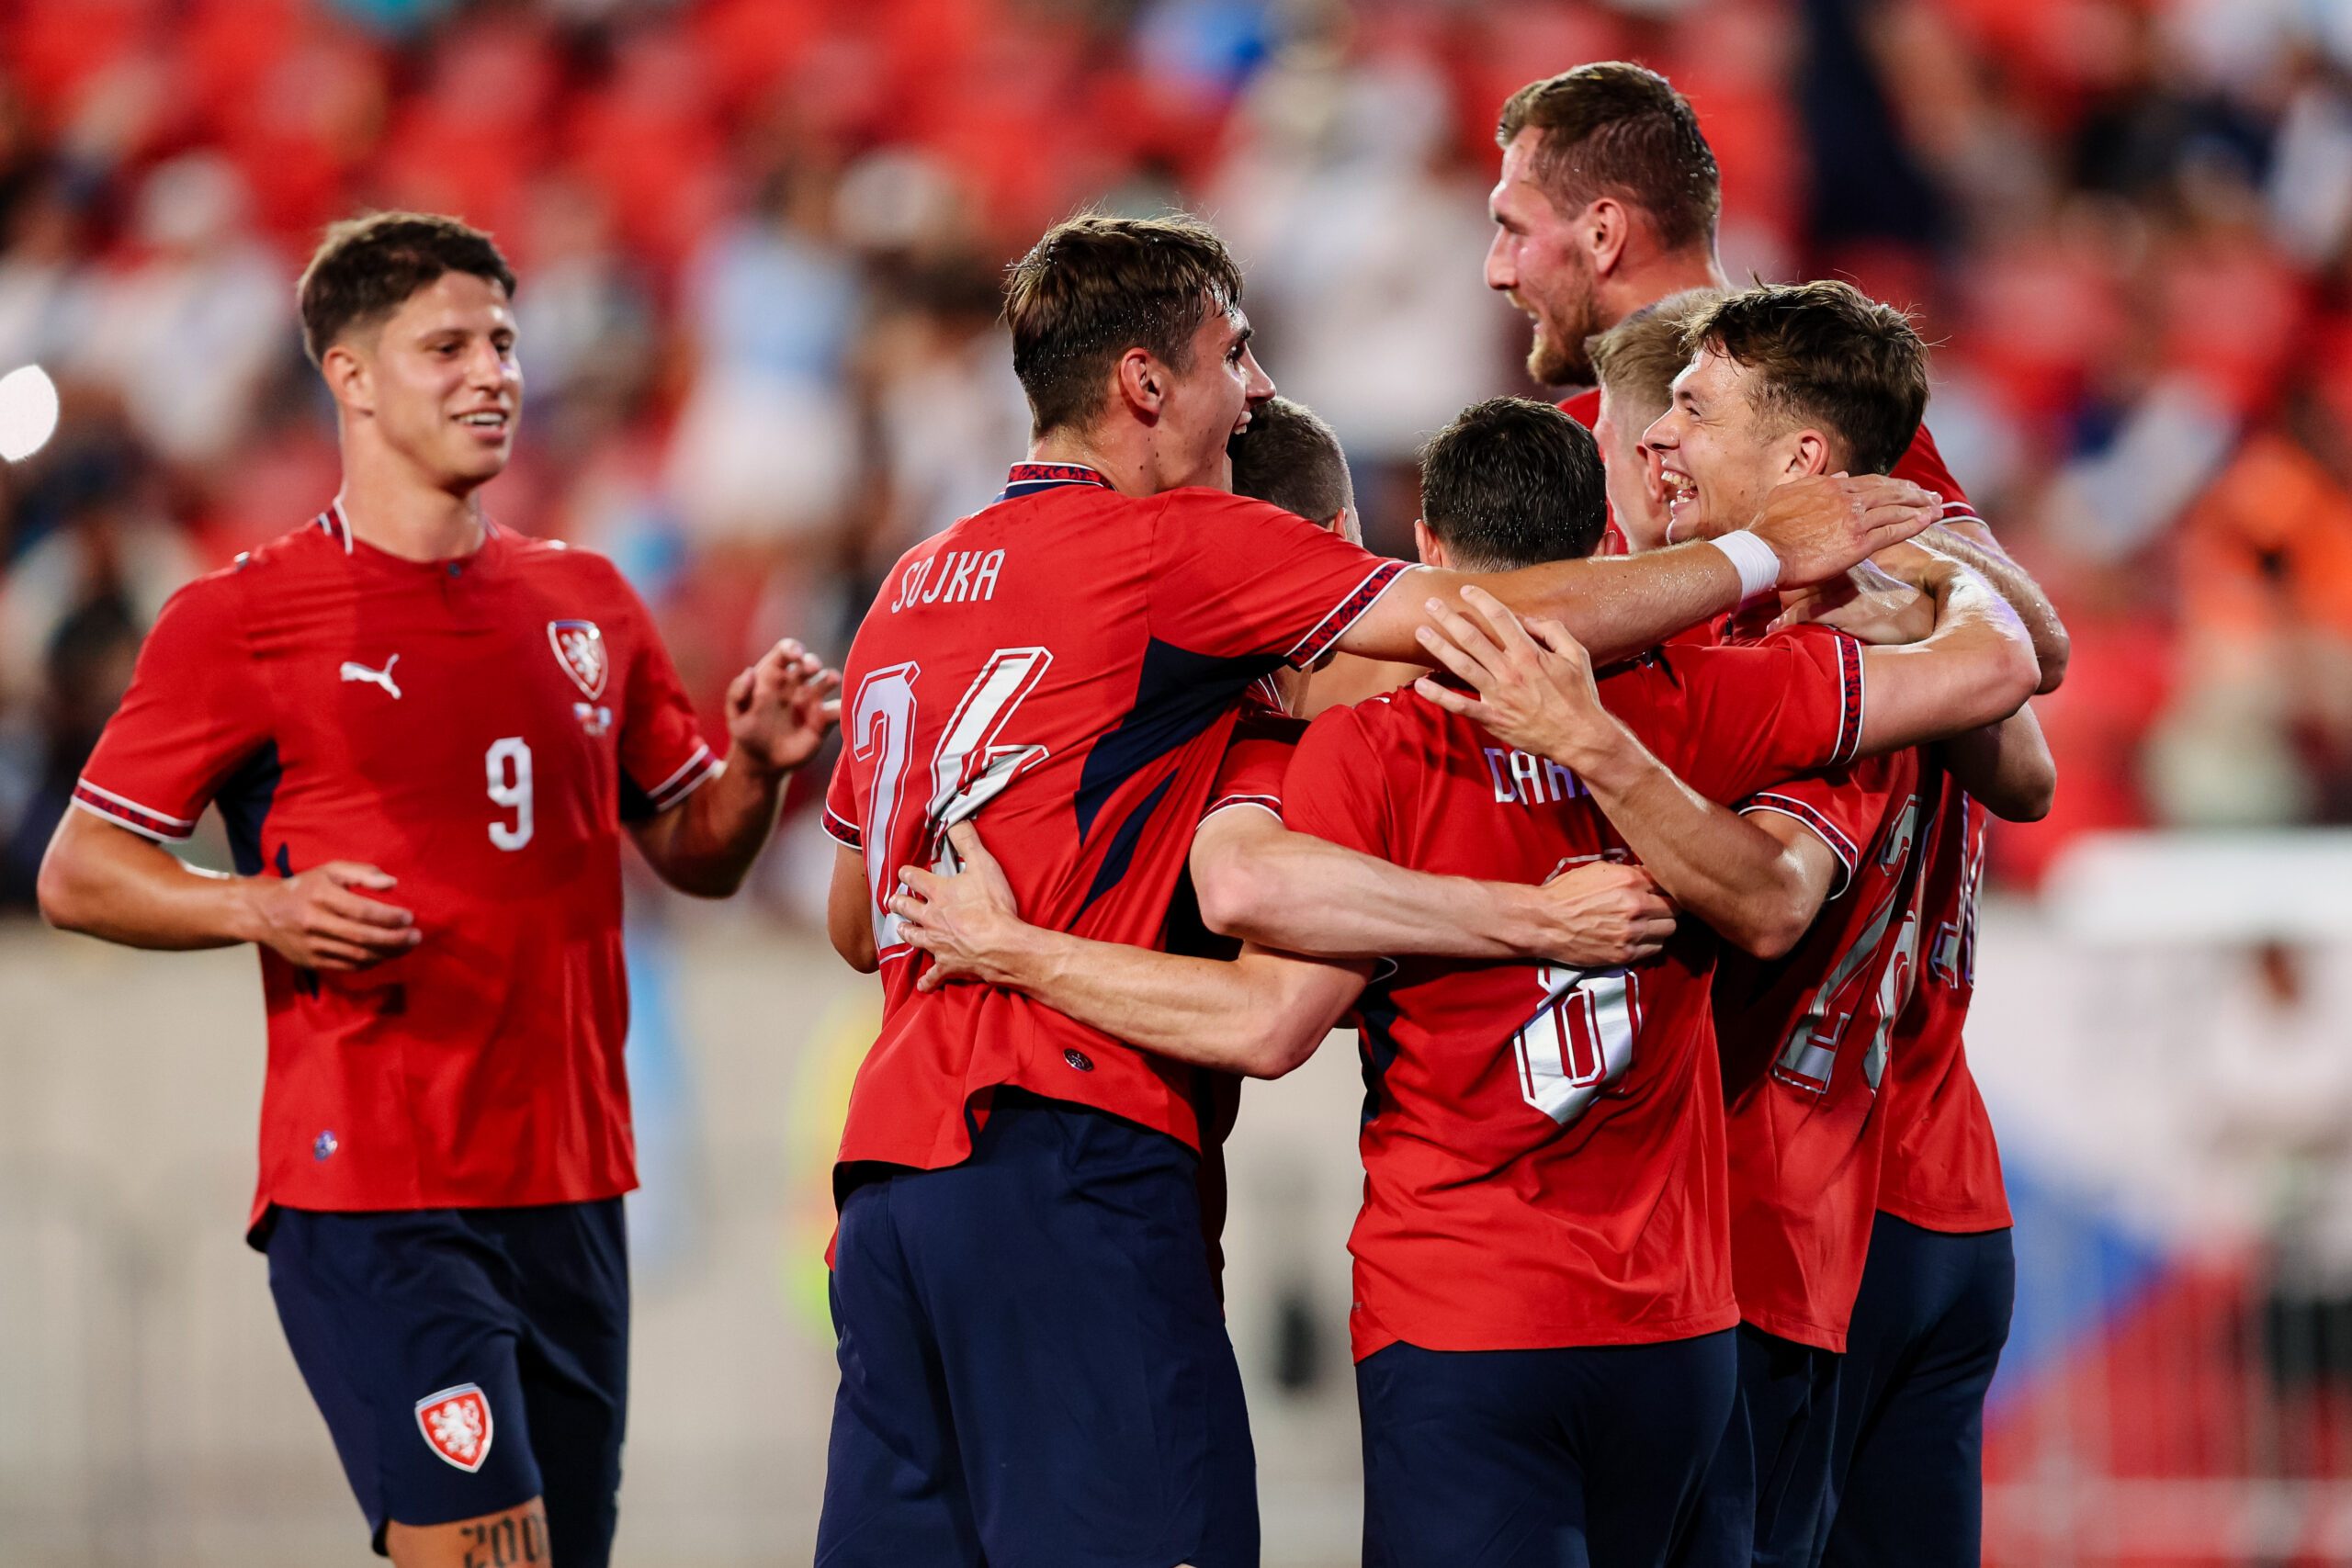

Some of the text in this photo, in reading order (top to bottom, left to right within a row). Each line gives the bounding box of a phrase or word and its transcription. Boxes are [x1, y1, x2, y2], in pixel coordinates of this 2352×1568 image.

[891, 548, 1007, 614] SOJKA
[485, 737, 534, 852] 9
[1484, 747, 1590, 805] DAR
